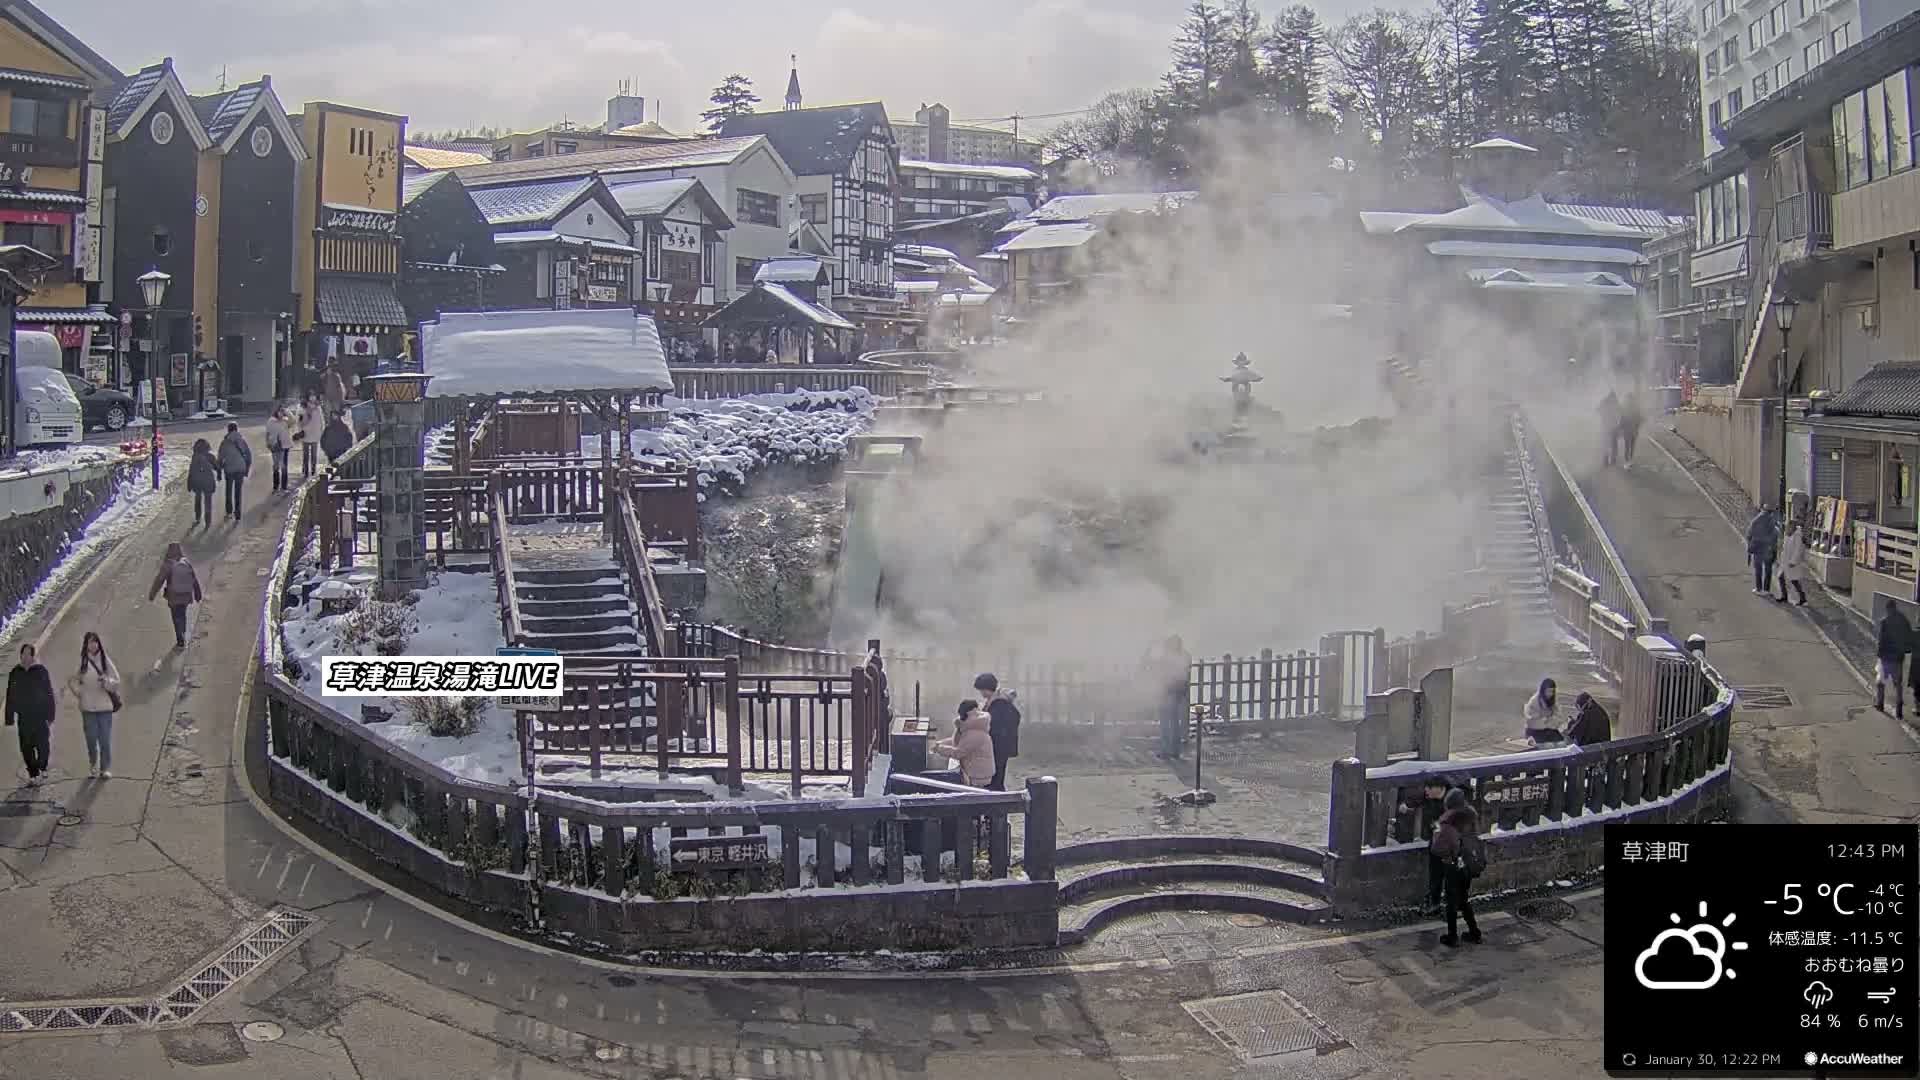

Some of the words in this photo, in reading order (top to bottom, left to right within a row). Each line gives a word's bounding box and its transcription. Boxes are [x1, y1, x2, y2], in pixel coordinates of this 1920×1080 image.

[698, 846, 724, 864] 東京
[728, 843, 768, 862] 軽井沢
